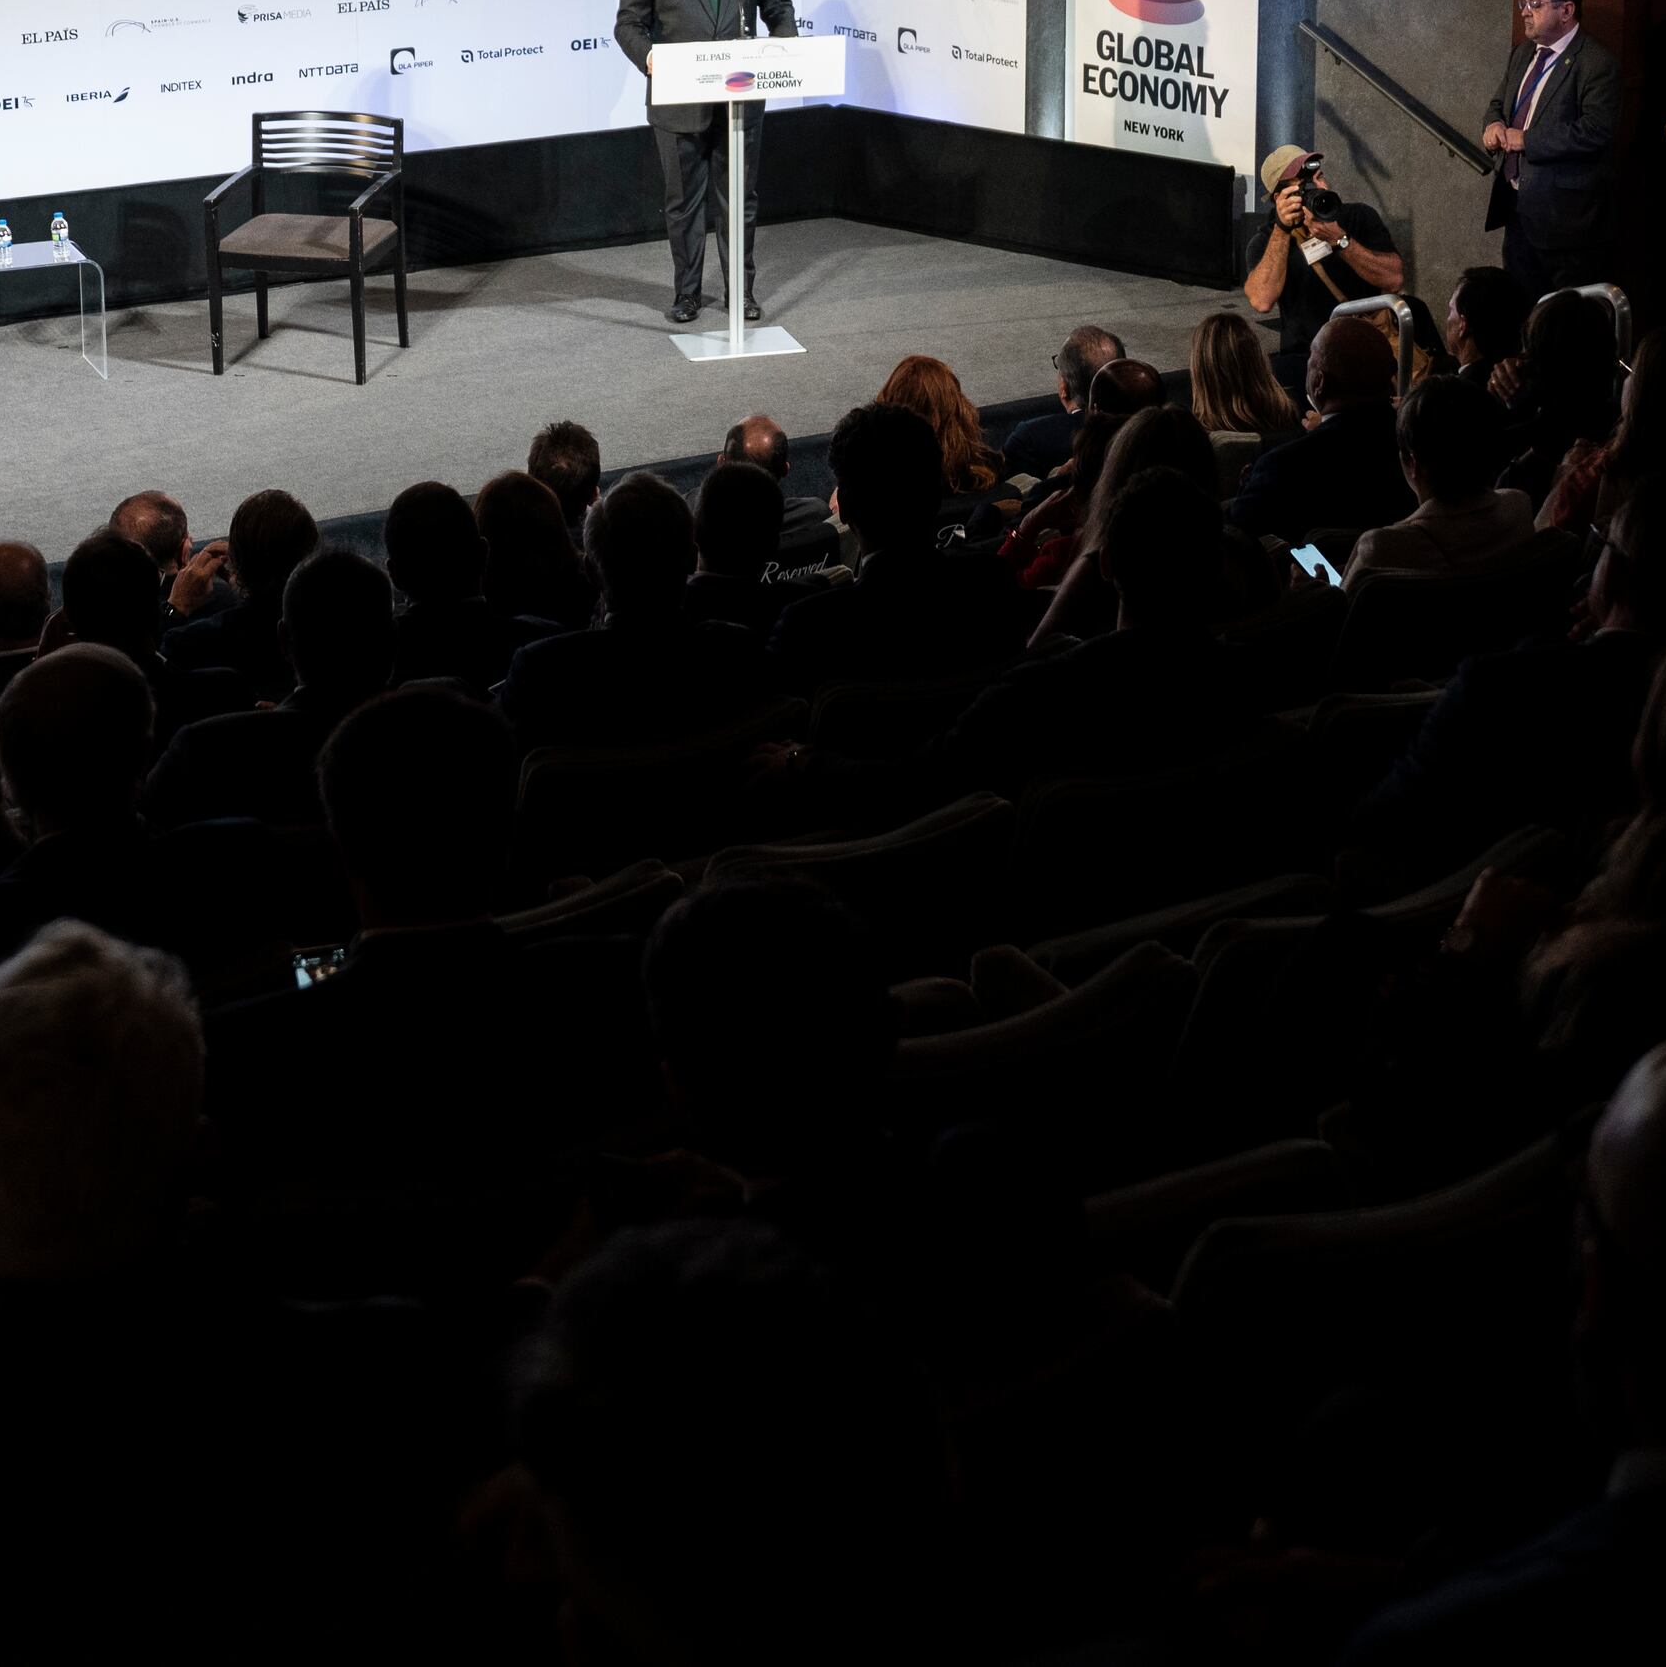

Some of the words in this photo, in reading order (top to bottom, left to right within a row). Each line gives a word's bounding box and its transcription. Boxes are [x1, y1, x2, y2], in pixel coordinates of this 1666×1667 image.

[337, 3, 357, 14] EL
[21, 32, 43, 45] EL
[45, 27, 79, 42] PAÍS
[571, 38, 597, 51] OEI
[477, 50, 502, 60] Total
[504, 45, 543, 58] Protect
[711, 53, 730, 61] PAÍS
[965, 50, 984, 62] Total
[987, 54, 1017, 68] Protect
[1096, 29, 1214, 79] GLOBAL
[414, 60, 433, 68] PIPER
[298, 67, 324, 78] NTT
[757, 71, 793, 79] GLOBAL
[161, 80, 202, 93] INDITEX
[757, 79, 803, 89] ECONOMY
[1083, 63, 1229, 118] ECONOMY
[66, 90, 112, 102] IBERIA
[1124, 119, 1150, 135] NEW
[1153, 122, 1184, 142] YORK
[760, 553, 828, 584] Reserved
